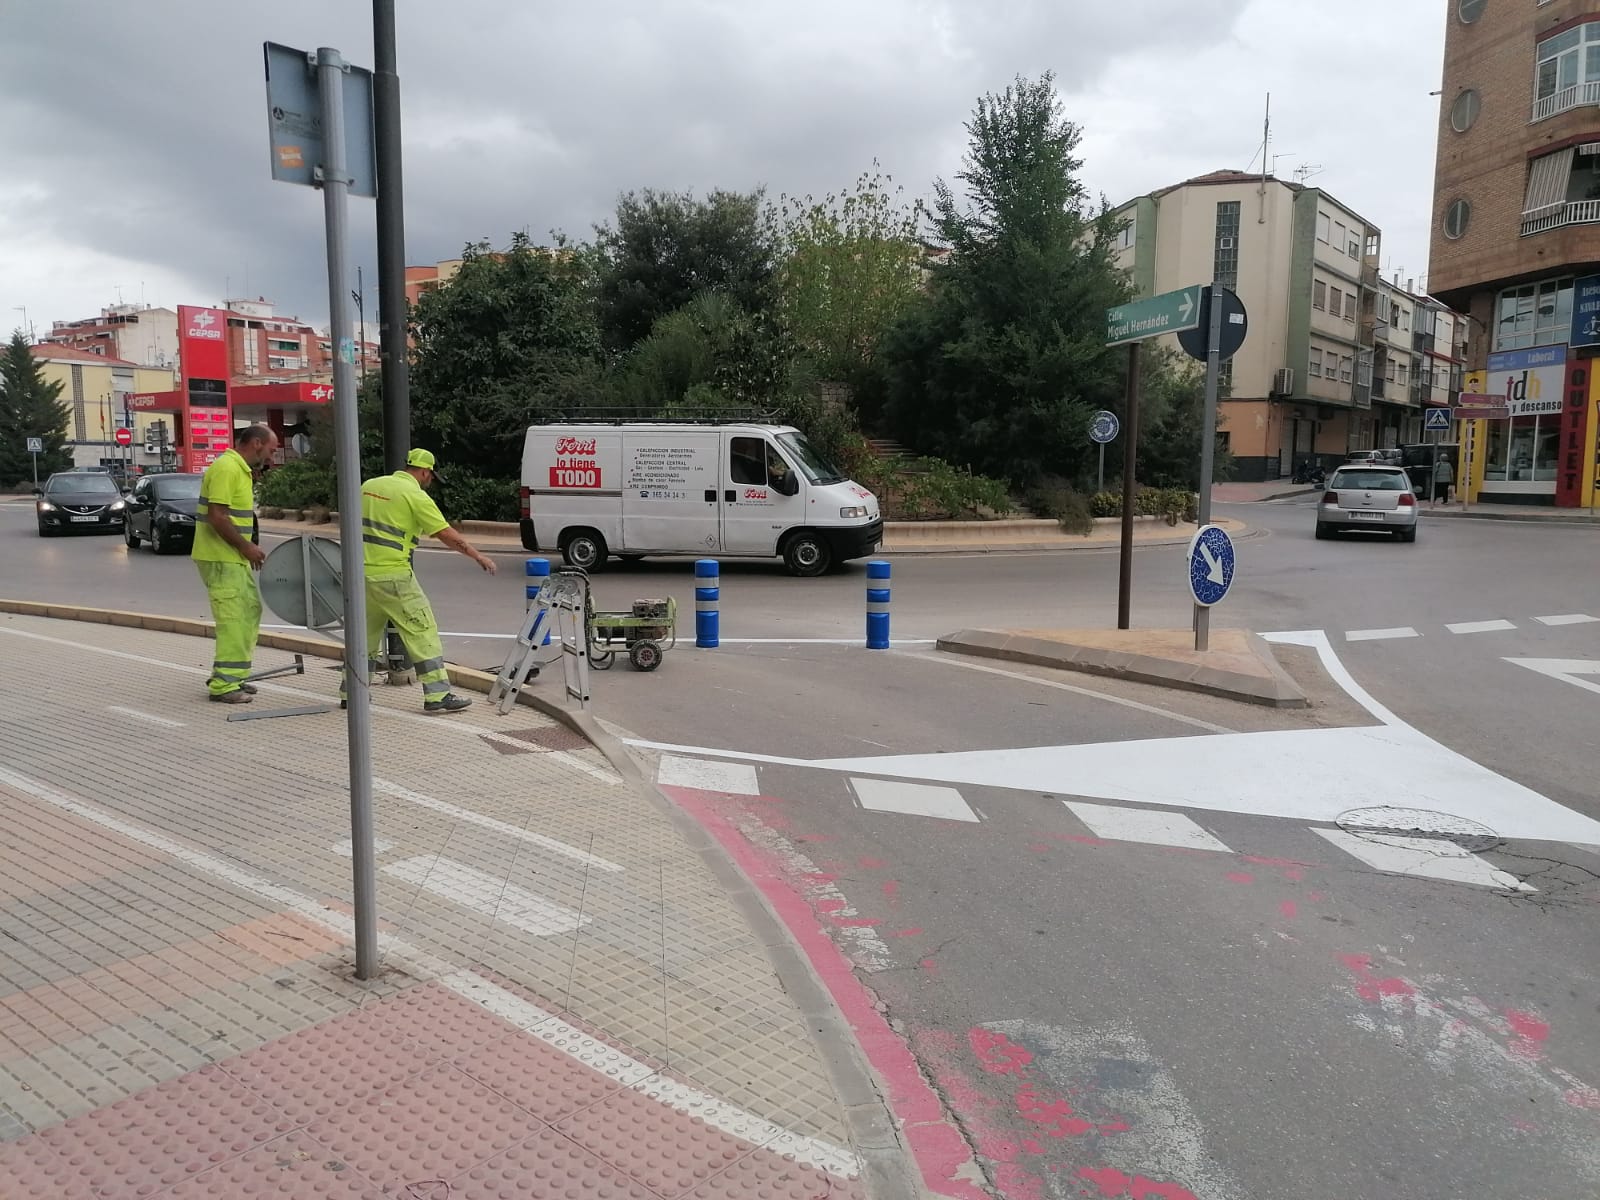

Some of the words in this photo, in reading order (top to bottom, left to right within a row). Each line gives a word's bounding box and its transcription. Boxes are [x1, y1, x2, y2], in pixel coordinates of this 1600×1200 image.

[1108, 311, 1123, 322] Calle
[189, 328, 220, 339] CEPSA
[1107, 321, 1129, 340] Miguel
[1507, 370, 1542, 401] tdh
[135, 395, 155, 407] CEPSA
[1512, 404, 1517, 414] y
[1520, 400, 1562, 412] descanso
[1565, 368, 1586, 490] OUTLET
[555, 437, 596, 455] Ferri
[557, 457, 566, 468] lo
[570, 457, 596, 469] tiene
[556, 470, 596, 486] TODO
